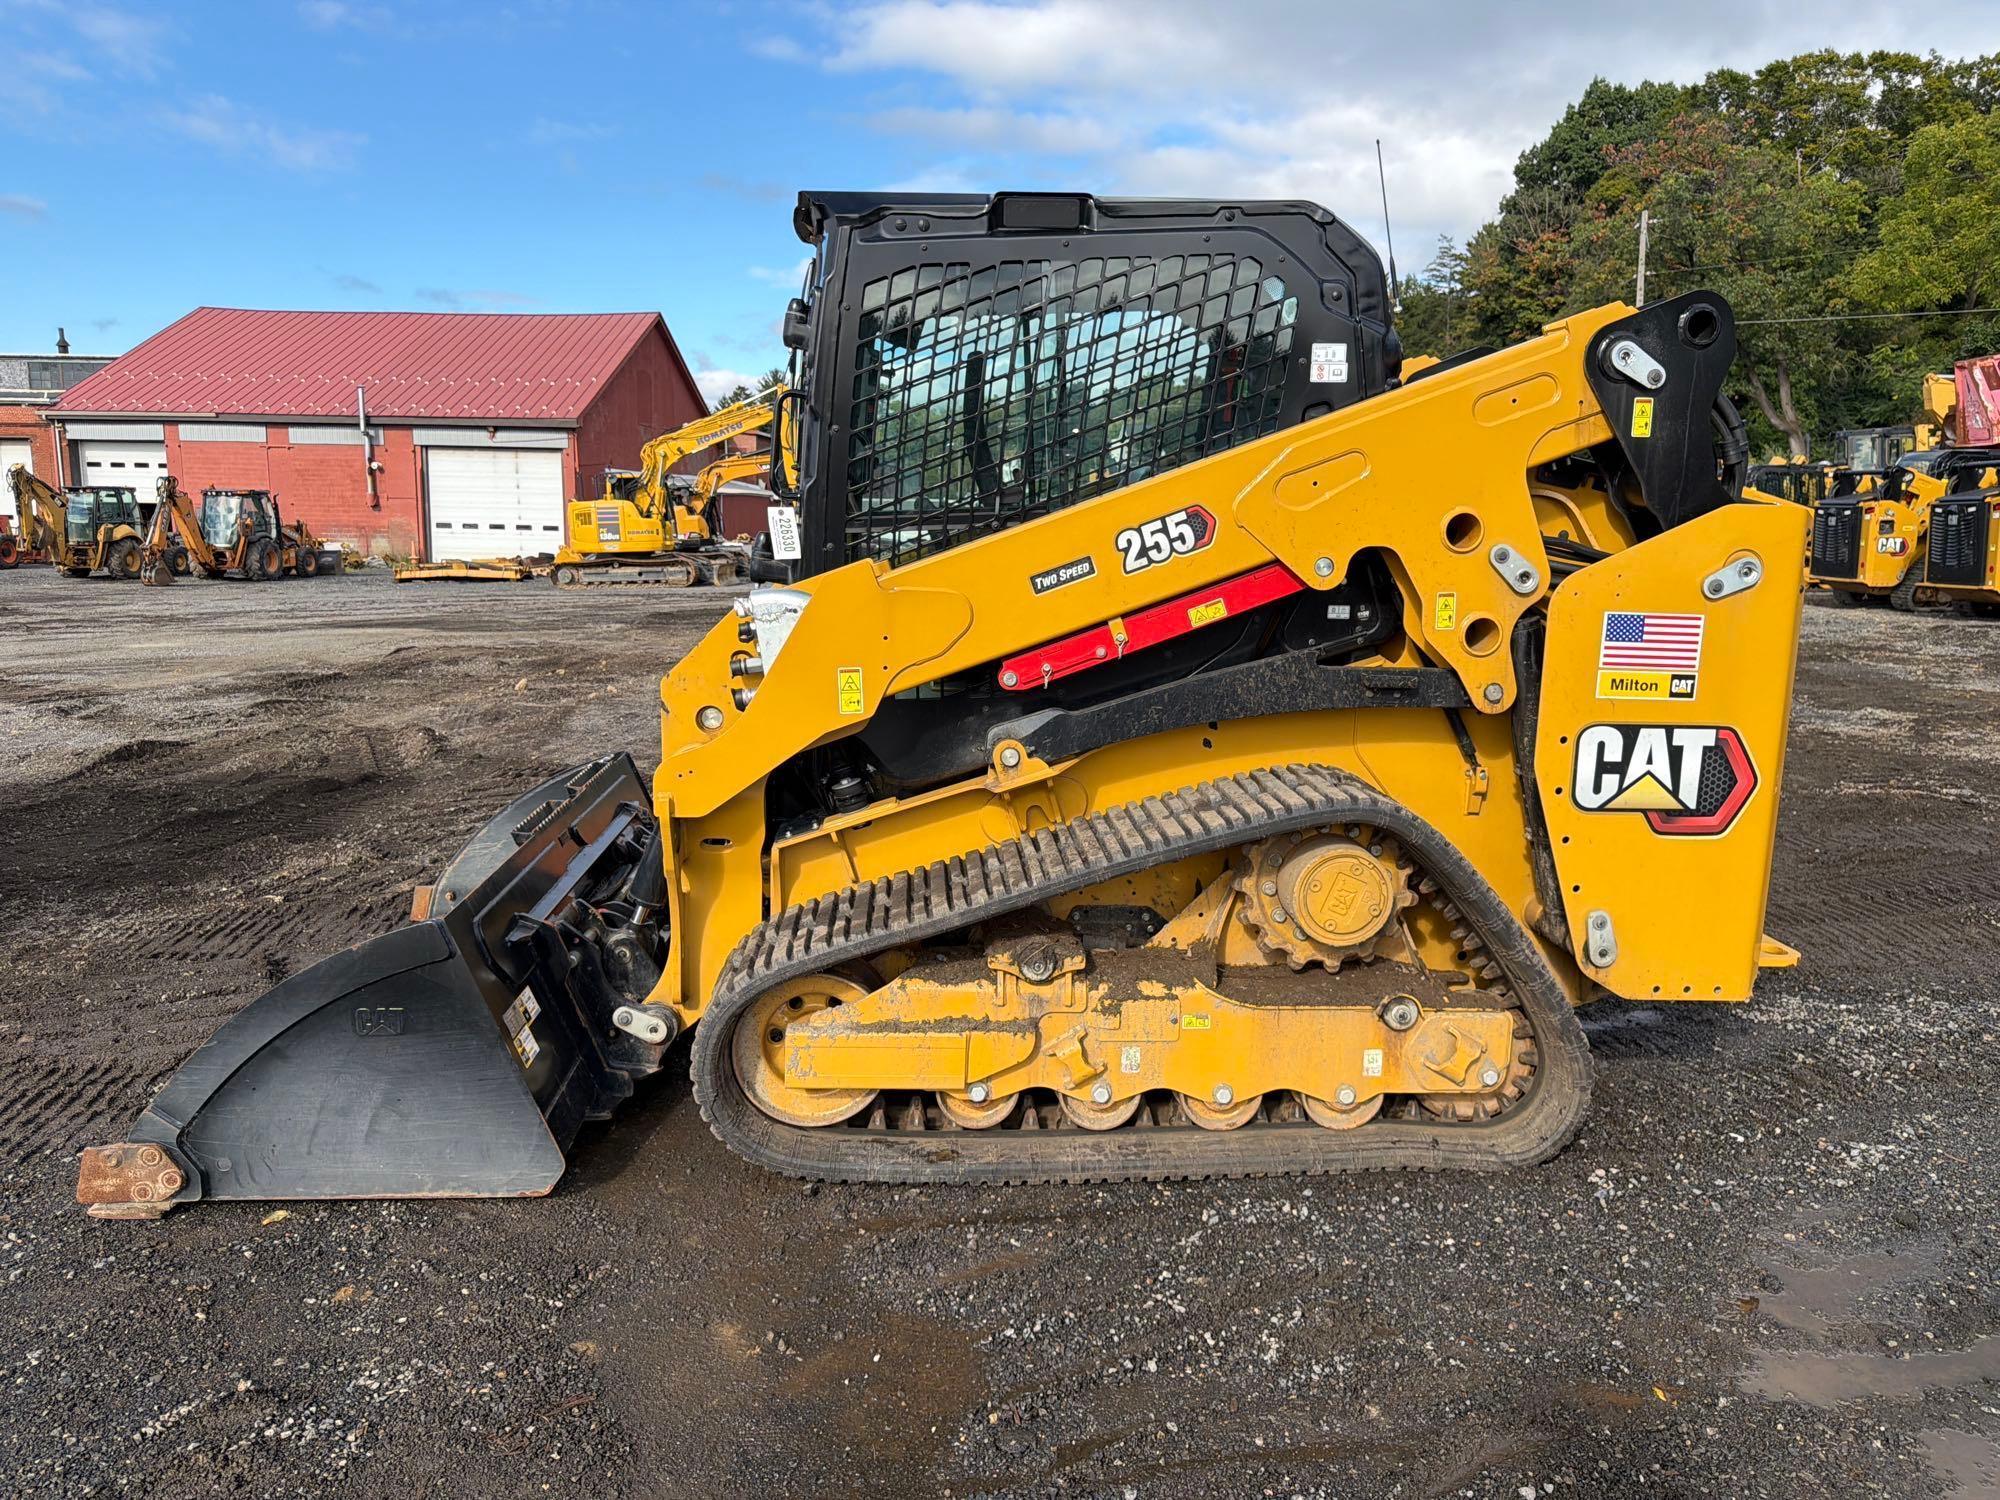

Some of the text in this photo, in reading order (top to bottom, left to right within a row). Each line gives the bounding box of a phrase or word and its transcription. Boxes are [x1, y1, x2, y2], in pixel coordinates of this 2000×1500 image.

[696, 422, 743, 445] KOMATSU
[779, 518, 796, 552] 226330
[1117, 510, 1196, 572] 255
[1877, 537, 1903, 553] CAT
[1610, 678, 1695, 693] Milton CAT
[1575, 725, 1717, 810] CAT
[354, 1007, 405, 1036] CAT
